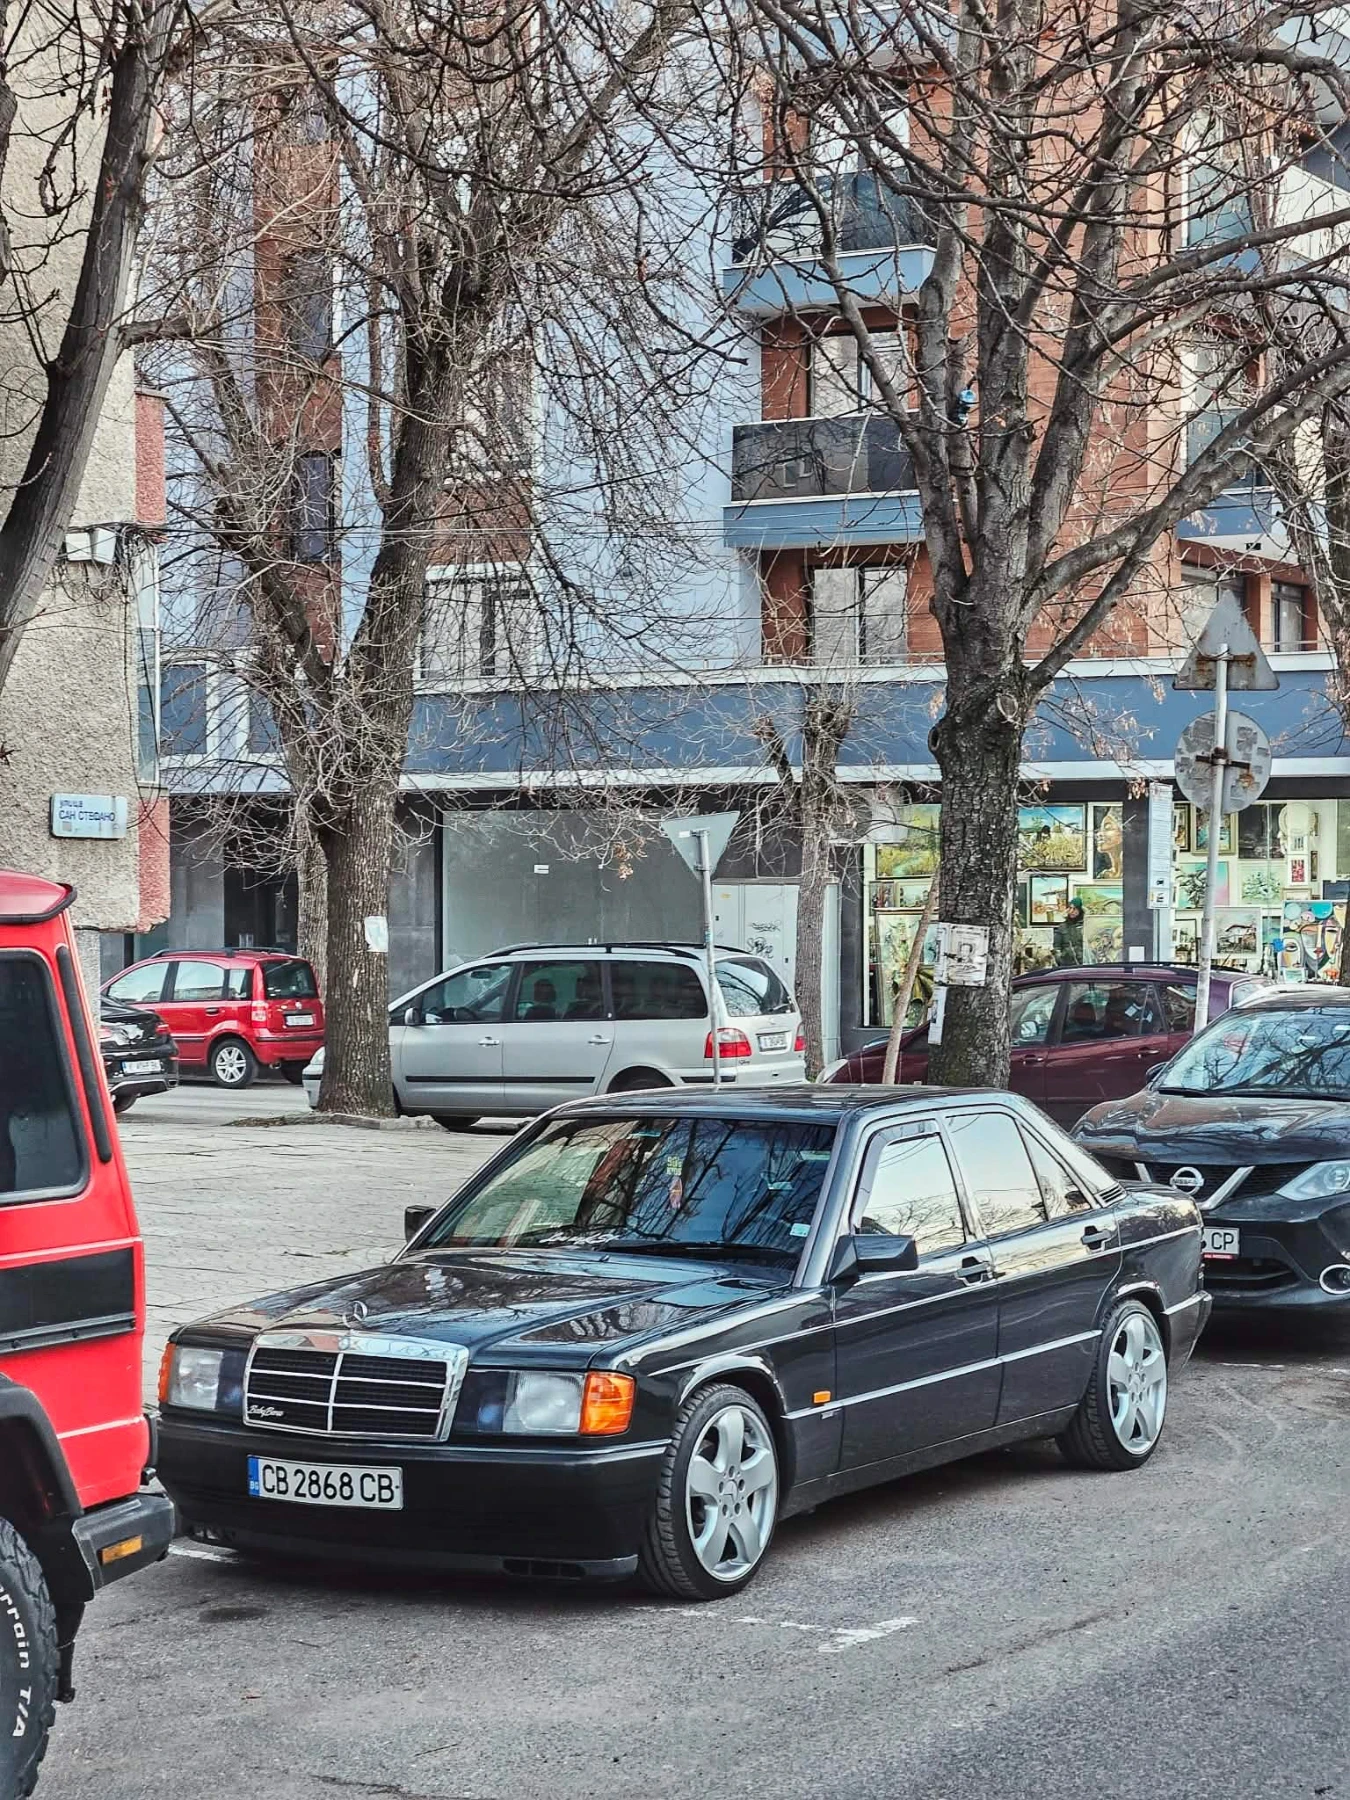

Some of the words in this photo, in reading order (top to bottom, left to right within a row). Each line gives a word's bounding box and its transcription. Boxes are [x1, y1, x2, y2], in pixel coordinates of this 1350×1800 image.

[59, 810, 76, 820] САН
[78, 811, 116, 822] СТЕФАНО
[1211, 1232, 1235, 1250] CP
[262, 1464, 289, 1495] CB
[293, 1469, 354, 1501] 2868
[360, 1473, 395, 1503] CB
[12, 1685, 32, 1737] T/A
